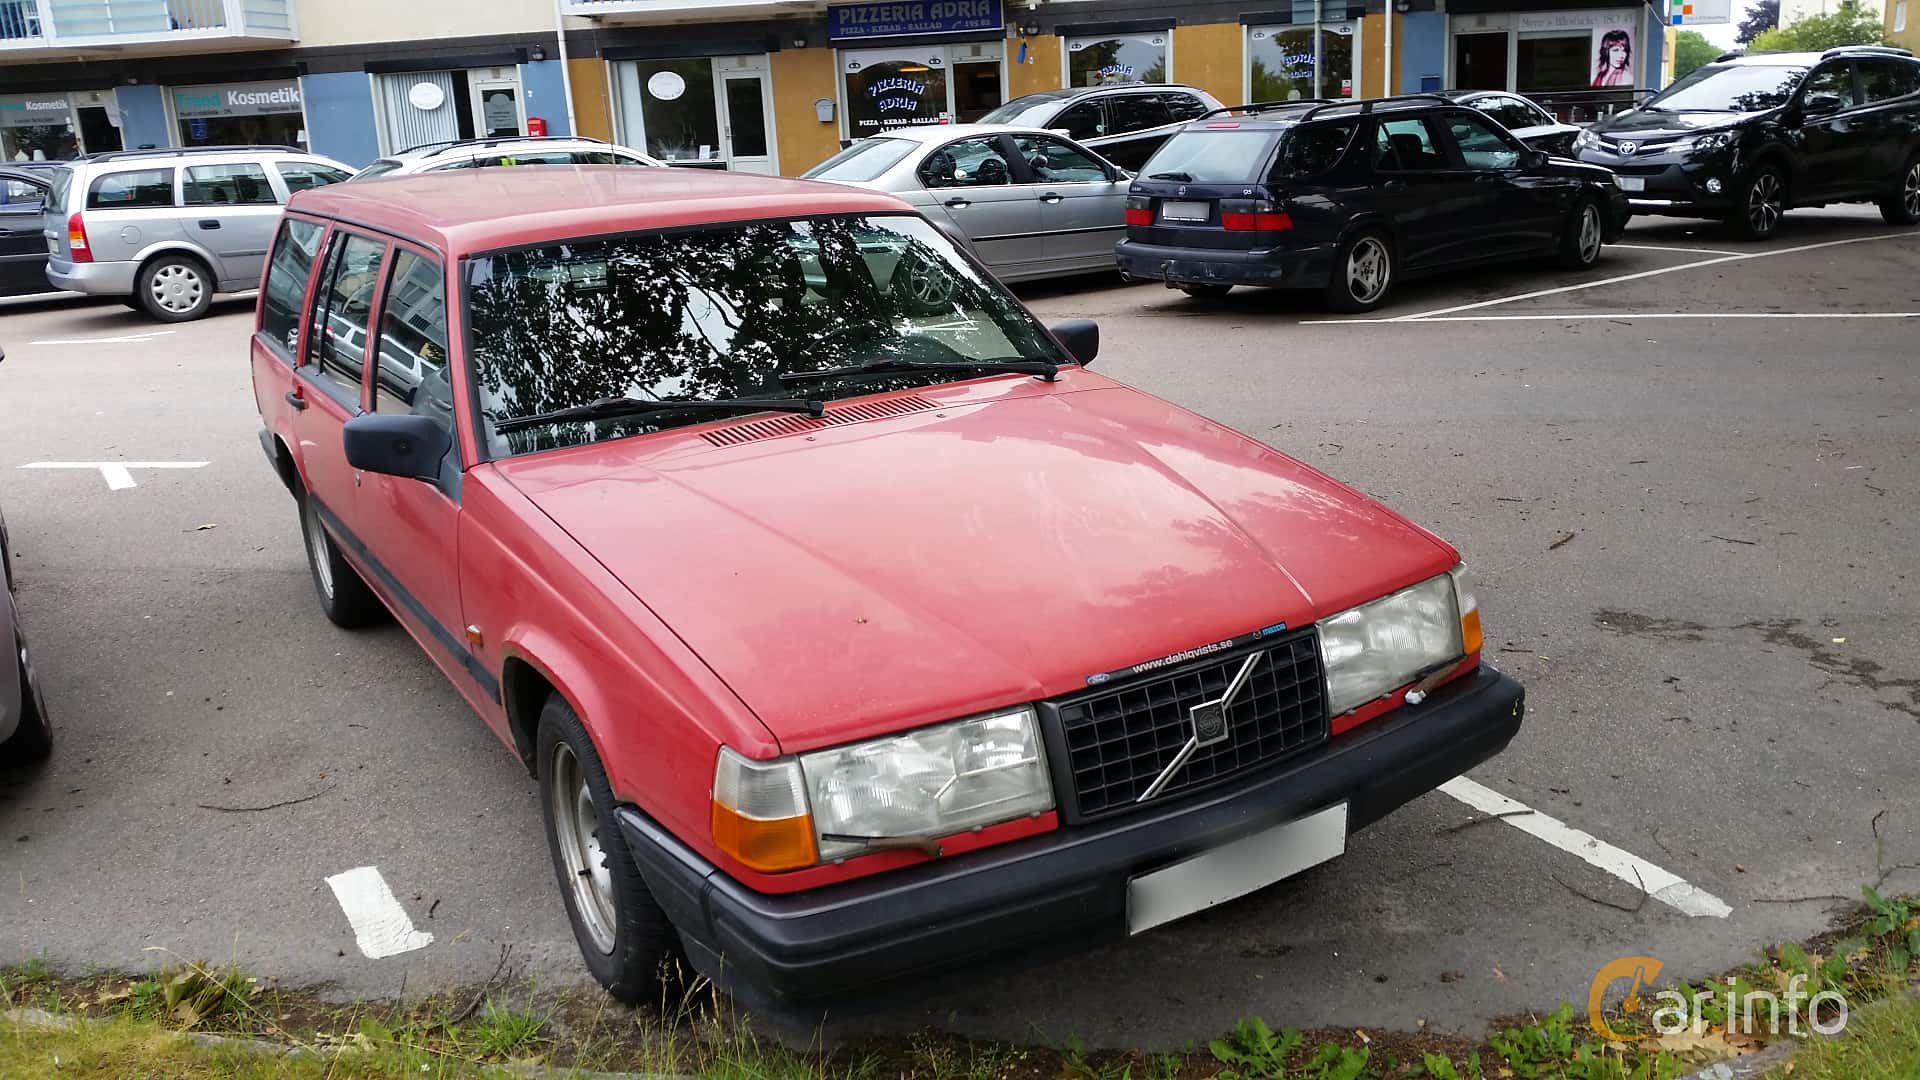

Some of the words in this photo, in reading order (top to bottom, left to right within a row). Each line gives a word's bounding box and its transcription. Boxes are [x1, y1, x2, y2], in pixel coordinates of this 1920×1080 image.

[839, 4, 924, 24] PIZZERIA
[930, 0, 990, 19] ADRIA
[872, 25, 901, 33] KEBAB
[908, 22, 942, 31] SALLAD
[227, 87, 300, 105] Kosmetik
[868, 78, 925, 96] PIZZERIA
[25, 99, 68, 111] Kosmetik
[879, 97, 917, 112] ADRIA
[1132, 638, 1233, 674] www.dahlqvists.se
